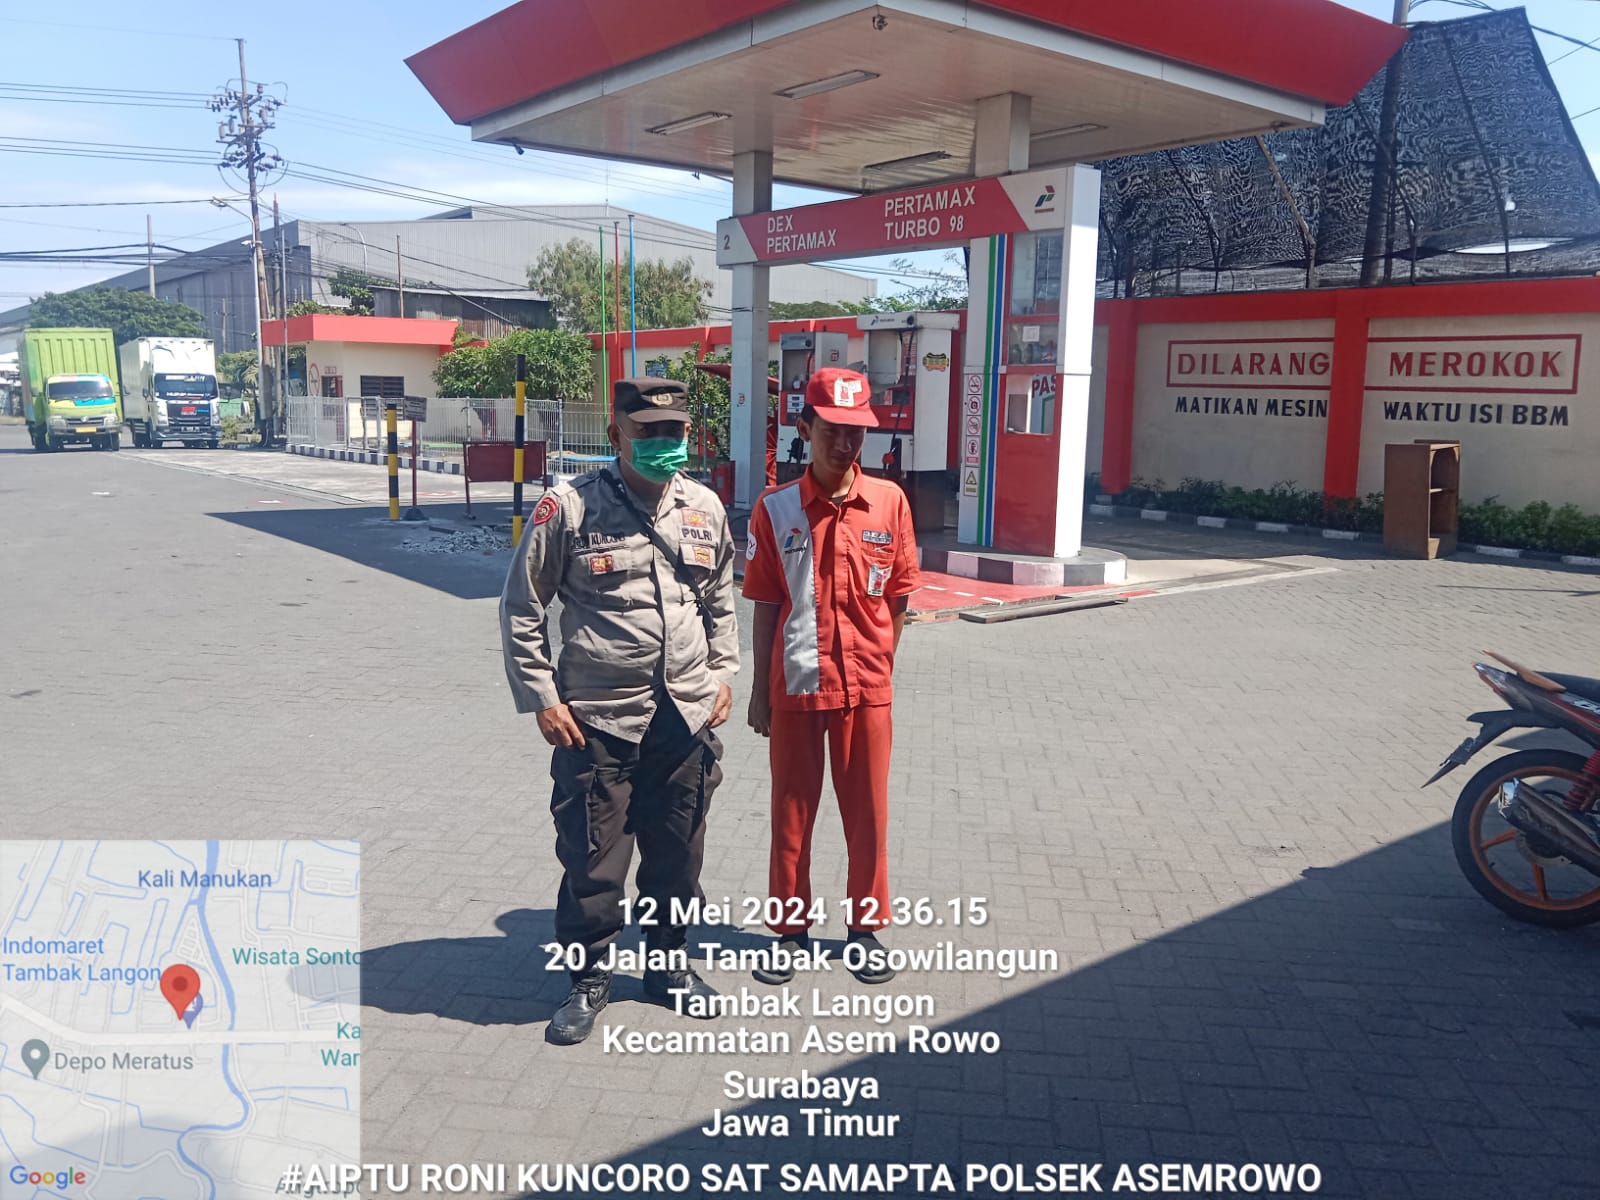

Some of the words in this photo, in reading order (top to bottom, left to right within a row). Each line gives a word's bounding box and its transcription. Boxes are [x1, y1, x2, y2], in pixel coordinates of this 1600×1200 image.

[884, 185, 976, 218] PERTAMAX
[766, 214, 794, 234] DEX
[884, 216, 941, 241] TURBO
[949, 215, 965, 233] 98
[723, 234, 731, 251] 2
[766, 228, 837, 255] PERTAMAX
[1177, 352, 1330, 376] DILARANG
[1389, 351, 1562, 378] MEROKOK
[1175, 396, 1259, 416] MATIKAN
[1265, 398, 1328, 418] MESIN
[1383, 400, 1462, 423] WAKTU
[1469, 402, 1504, 425] ISI
[1511, 404, 1570, 427] BBM
[682, 528, 712, 542] POLRI
